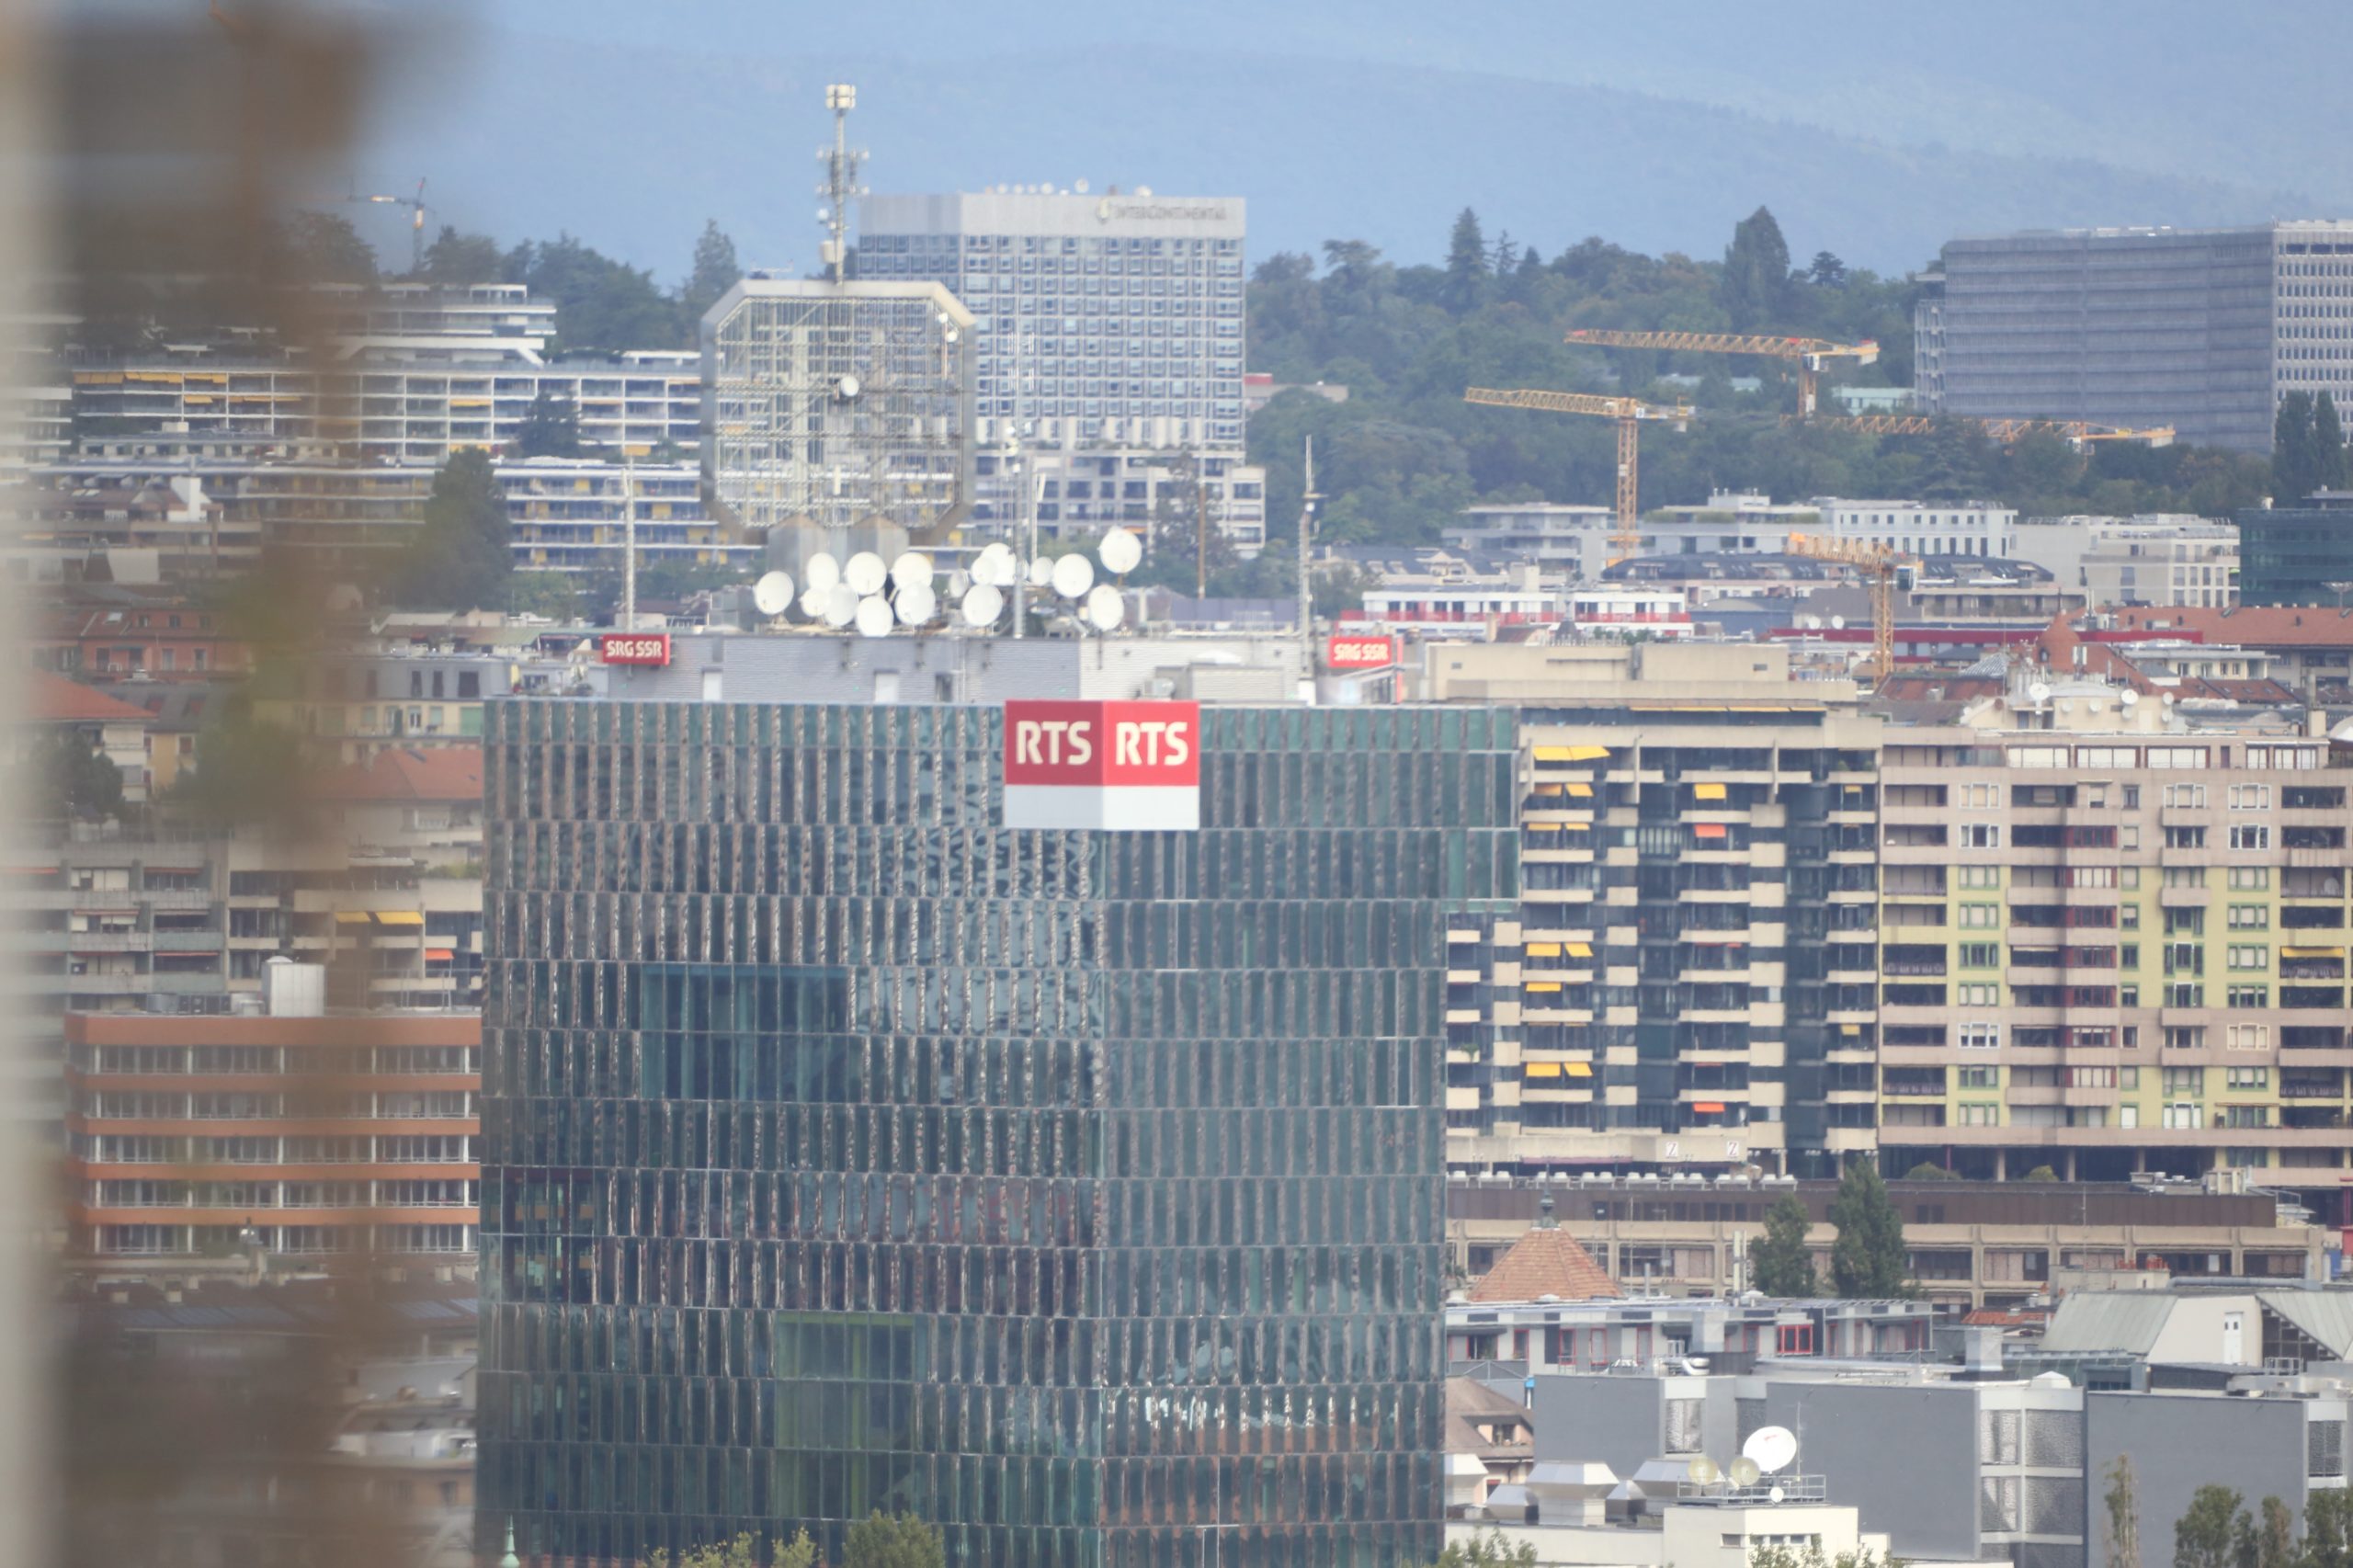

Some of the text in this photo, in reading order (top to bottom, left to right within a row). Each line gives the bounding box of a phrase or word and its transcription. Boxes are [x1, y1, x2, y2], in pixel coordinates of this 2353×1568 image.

[606, 640, 663, 658] SRG SSR
[1333, 642, 1389, 661] SRG SSR
[1016, 720, 1093, 766] RTS
[1115, 721, 1188, 766] RTS
